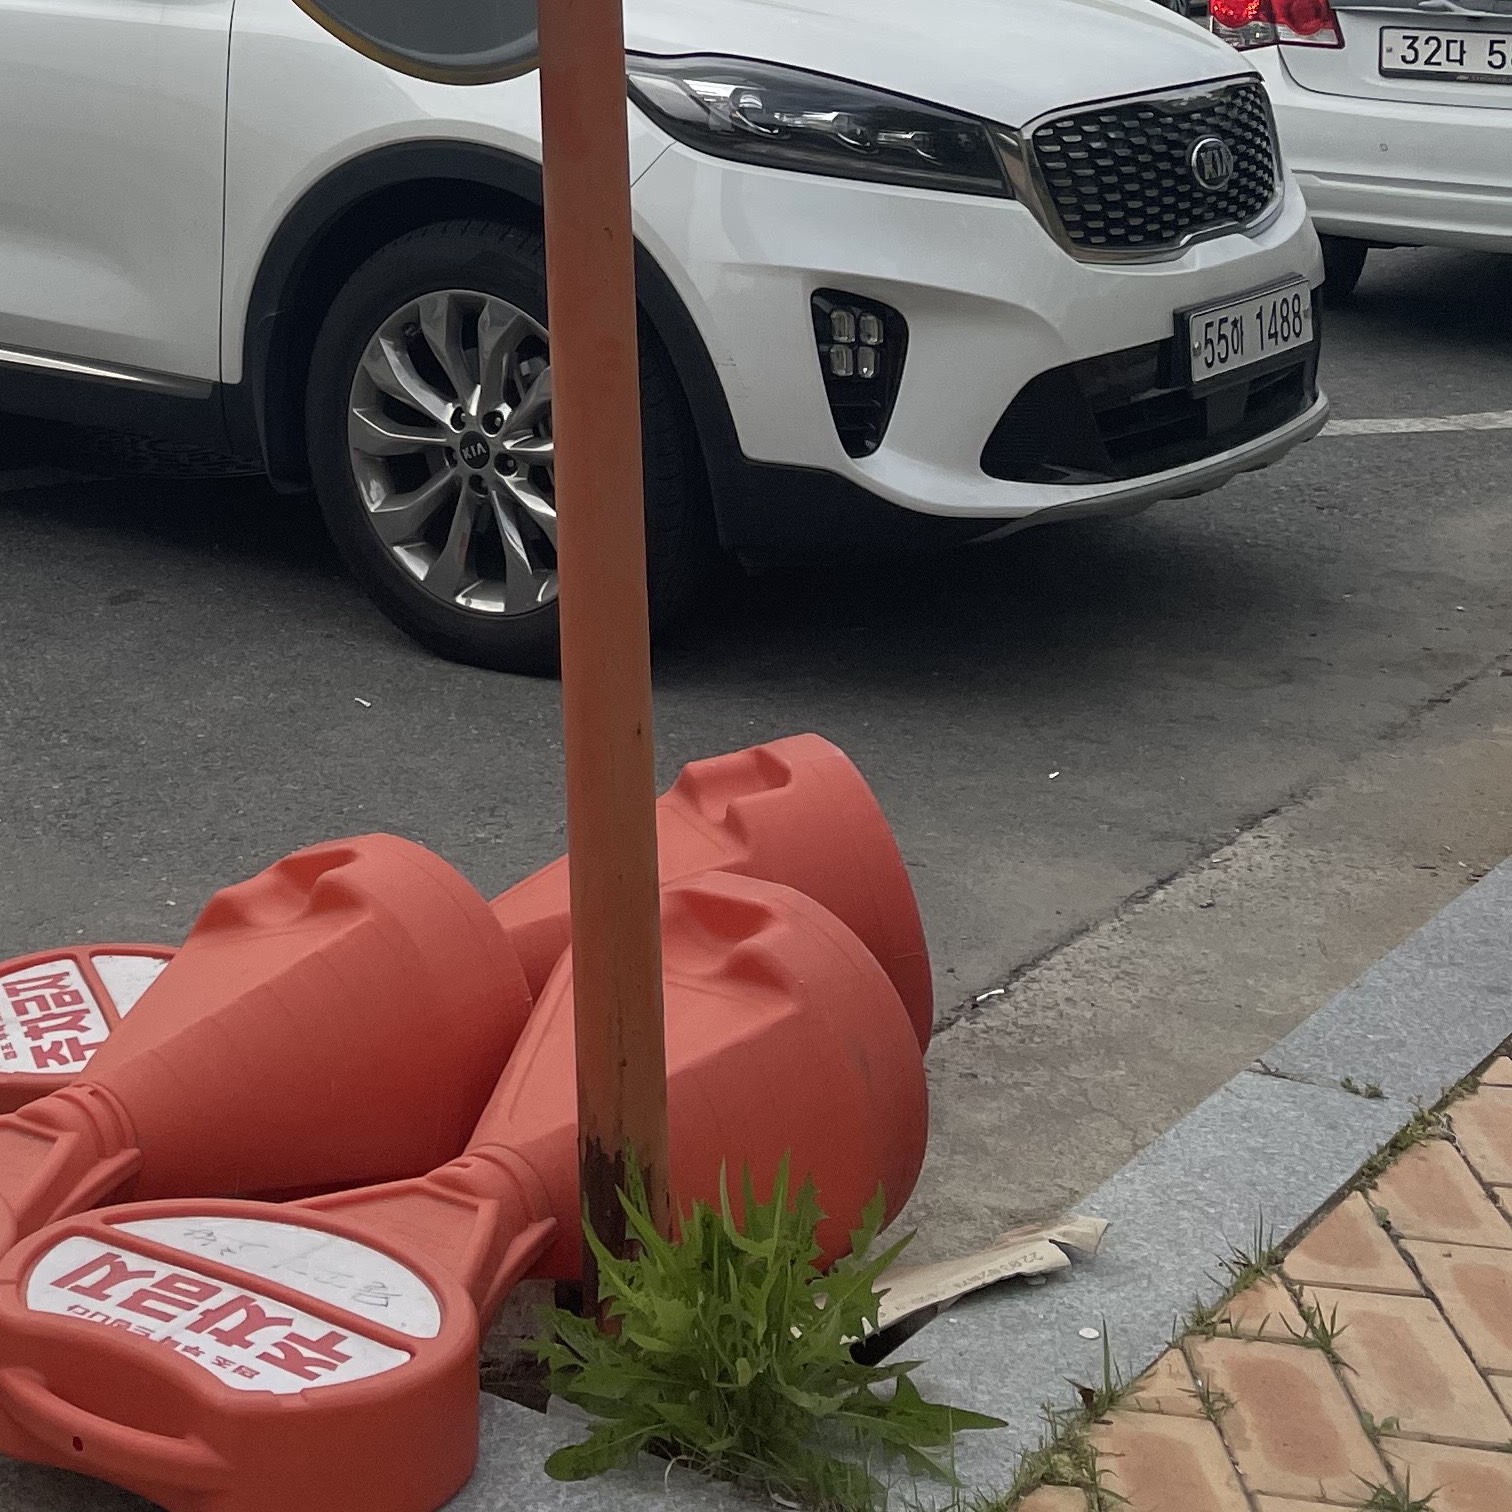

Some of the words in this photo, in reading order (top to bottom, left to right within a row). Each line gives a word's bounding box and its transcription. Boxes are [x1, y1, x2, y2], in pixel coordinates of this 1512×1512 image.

[1400, 35, 1467, 67] 32다
[1487, 39, 1512, 70] 5
[1200, 147, 1232, 180] KIA
[1255, 293, 1303, 351] 1488
[461, 442, 487, 460] KIA
[2, 972, 100, 1069] 주차금지
[49, 1252, 353, 1381] 주차금지
